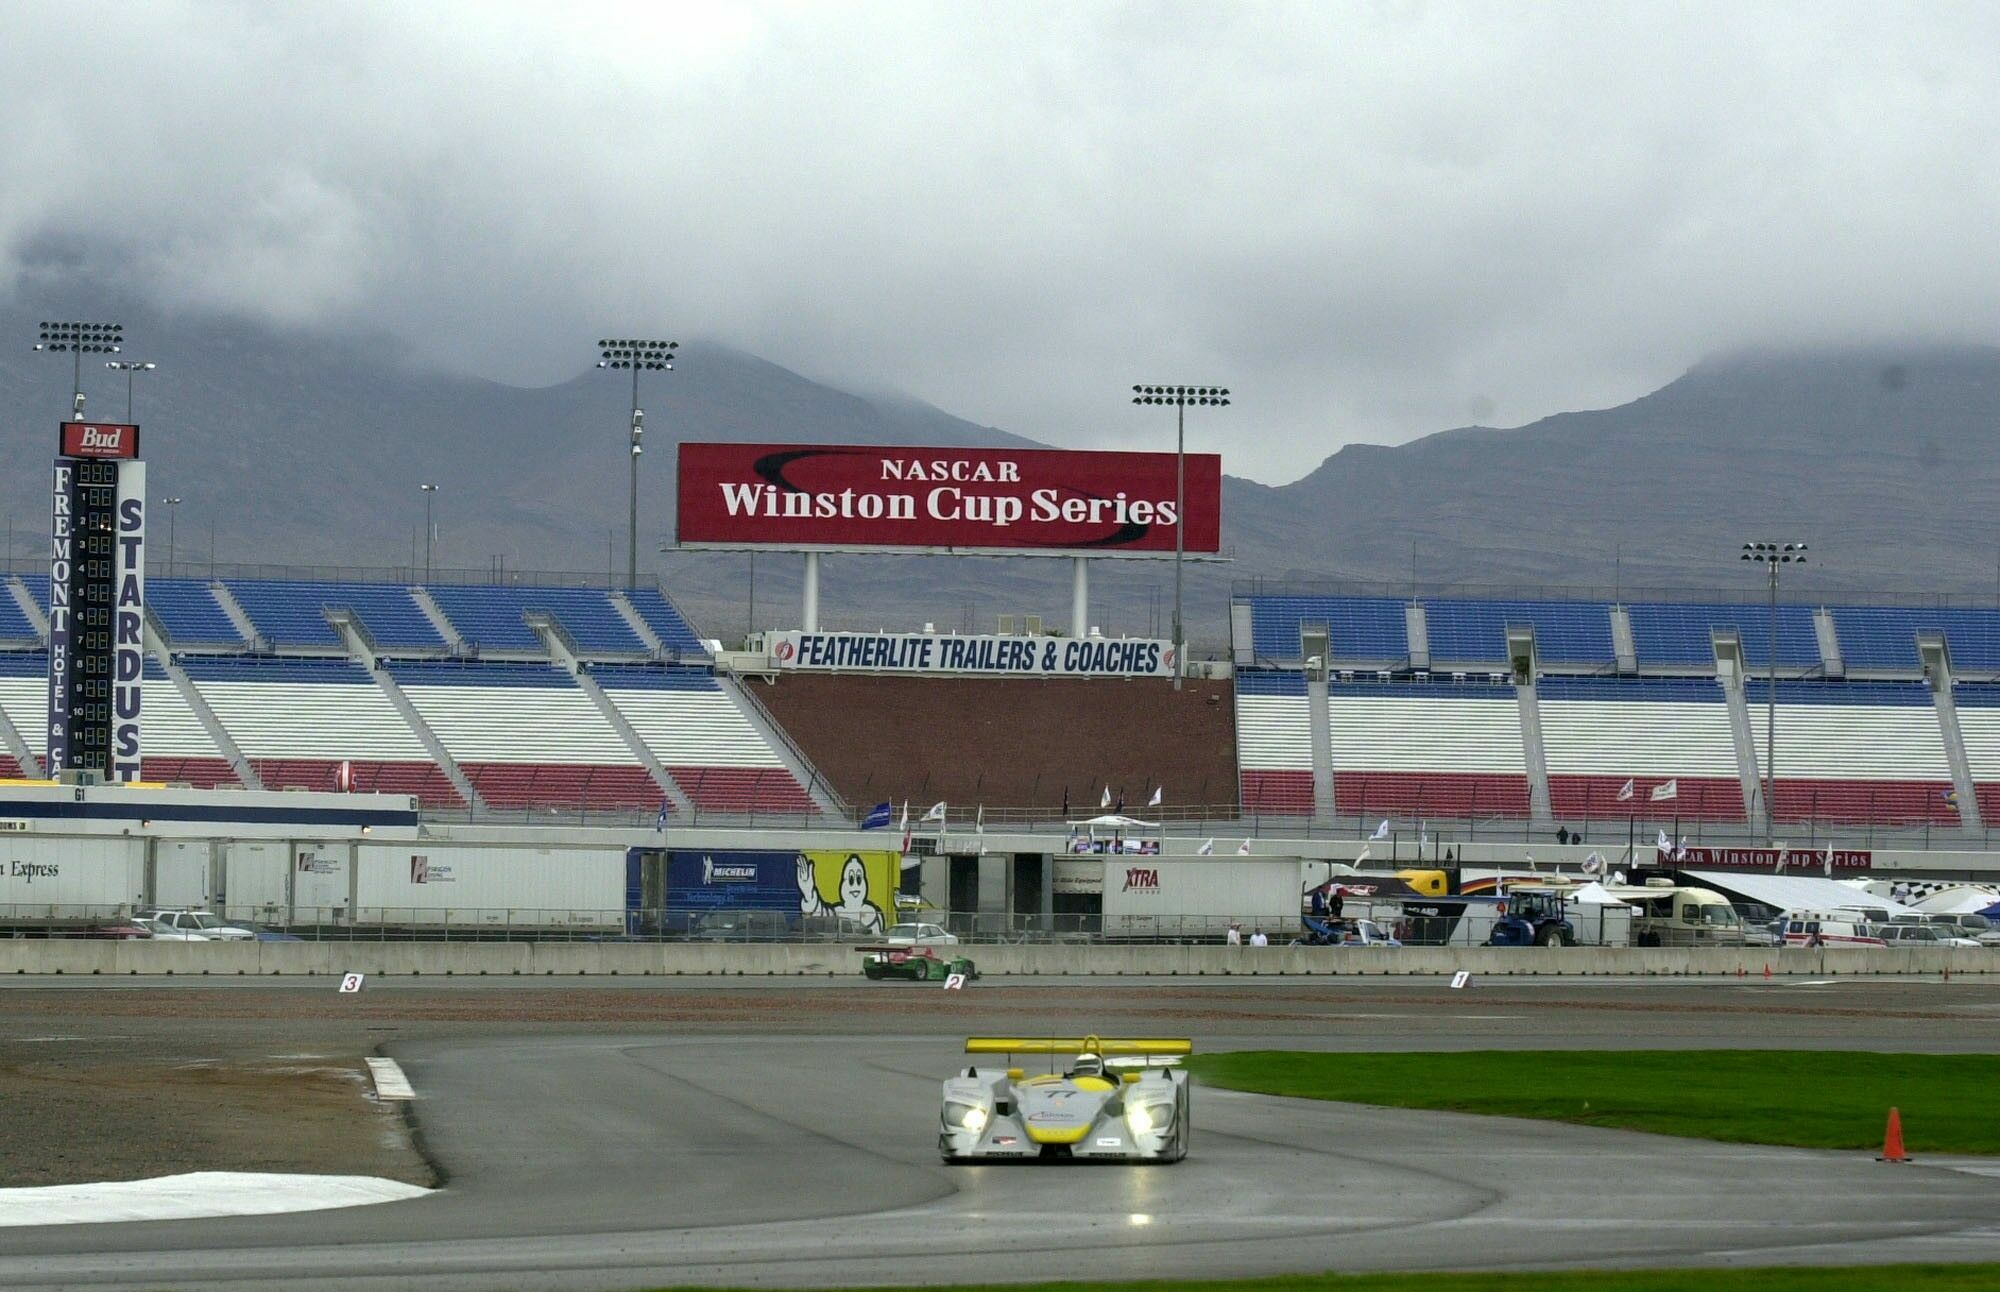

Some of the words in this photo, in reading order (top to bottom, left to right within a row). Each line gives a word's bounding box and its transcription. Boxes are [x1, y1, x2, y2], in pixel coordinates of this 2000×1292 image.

[80, 427, 121, 448] Bud
[880, 459, 1021, 482] NASCAR
[718, 483, 917, 519] Winston
[927, 487, 1023, 525] Cup
[1030, 489, 1178, 525] Series
[52, 467, 72, 632] FREMONT
[115, 498, 143, 782] STARDUST
[797, 635, 933, 668] FEATHERLITE
[940, 638, 1036, 671] TRAILERS
[1041, 641, 1057, 671] &
[1064, 641, 1160, 673] COACHES
[53, 645, 65, 713] HOTEL
[76, 684, 83, 692] 9
[73, 707, 84, 716] 10
[52, 724, 64, 736] &
[74, 732, 83, 740] 11
[73, 756, 83, 764] 12
[75, 788, 85, 801] G1
[1711, 850, 1774, 865] Winston
[1816, 852, 1867, 867] Sries
[11, 860, 60, 884] Express
[713, 867, 756, 877] MICHELIN
[1122, 868, 1159, 892] XTRA
[344, 975, 358, 991] 3
[949, 975, 961, 989] 2
[1457, 974, 1466, 987] 1
[1043, 1090, 1078, 1099] 77
